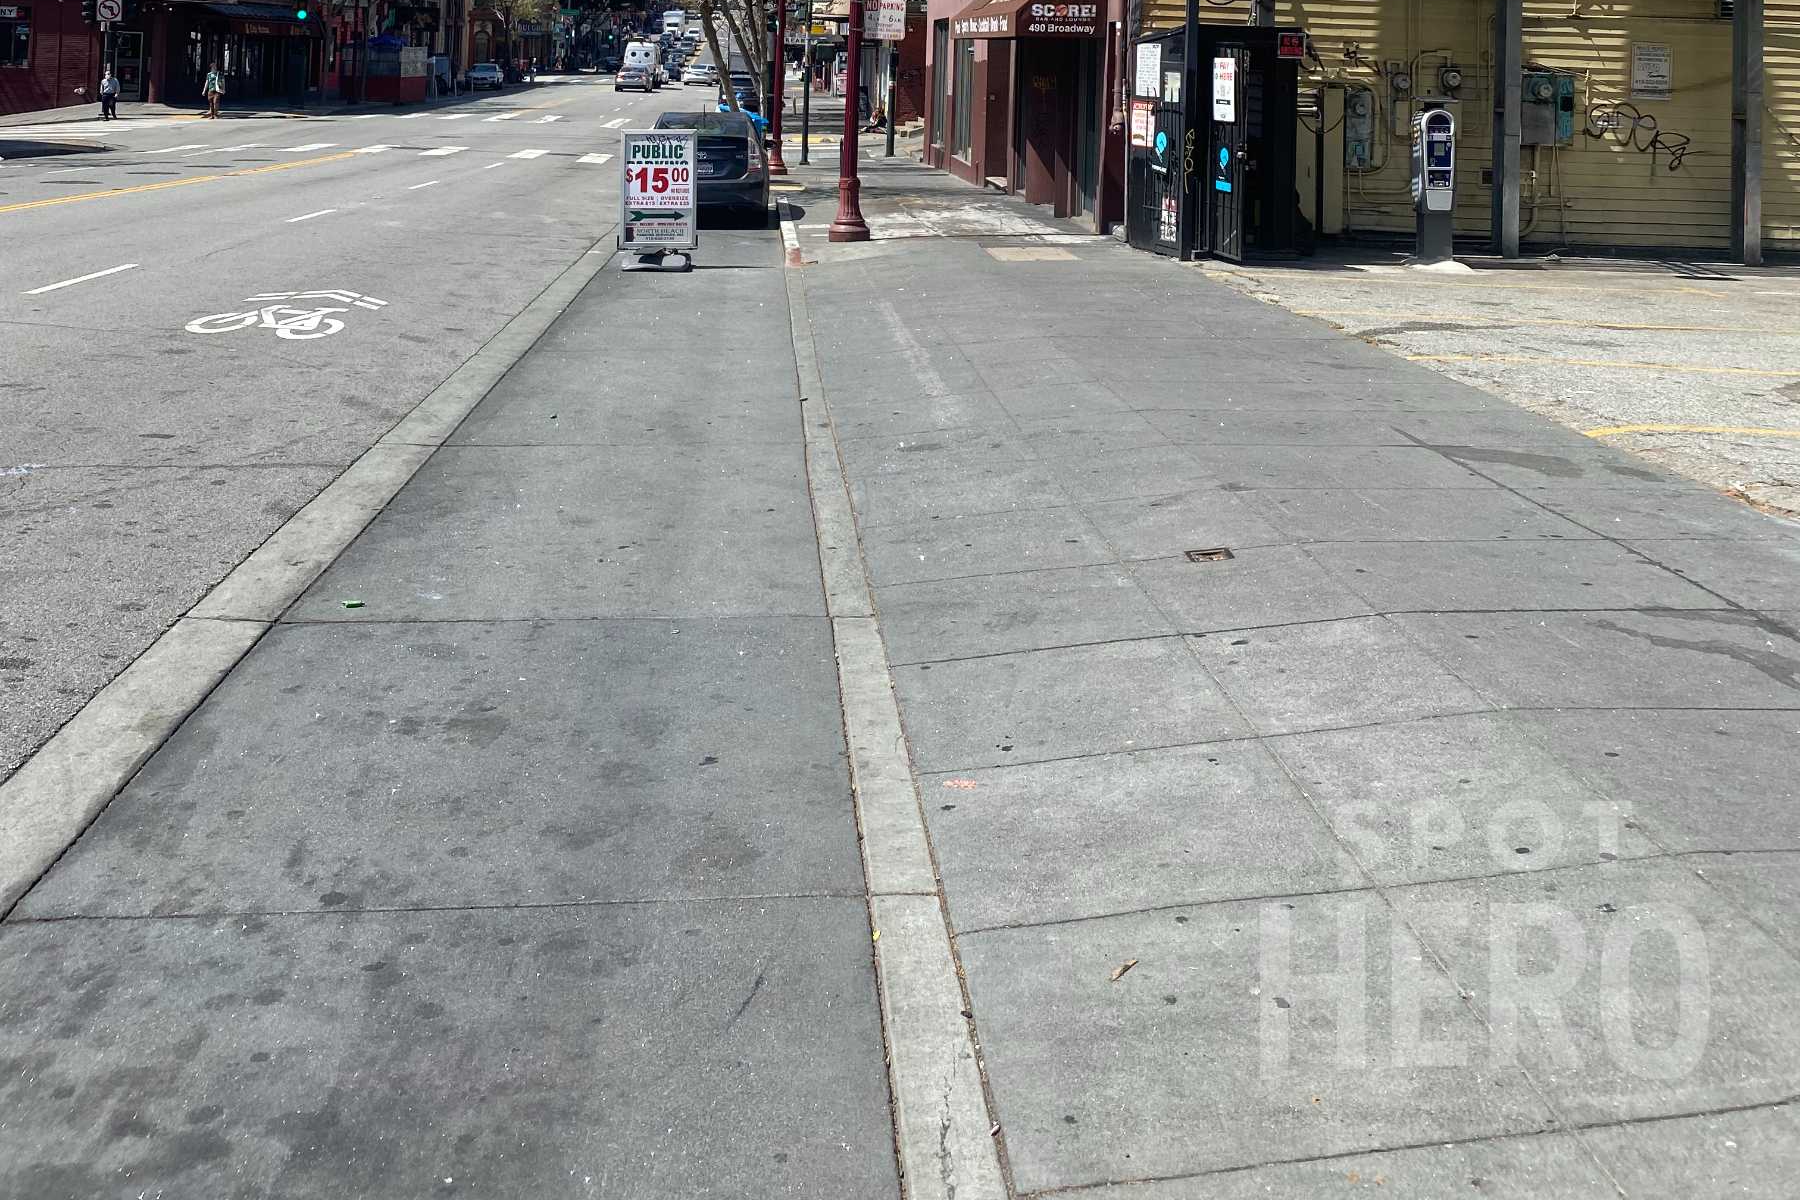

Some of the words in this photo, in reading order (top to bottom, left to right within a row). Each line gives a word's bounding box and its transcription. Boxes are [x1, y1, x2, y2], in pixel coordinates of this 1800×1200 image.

[866, 0, 878, 11] NO
[880, 2, 904, 13] PARKING
[1028, 23, 1046, 33] 490
[1047, 23, 1095, 34] Broadway
[632, 144, 684, 159] PUBLIC
